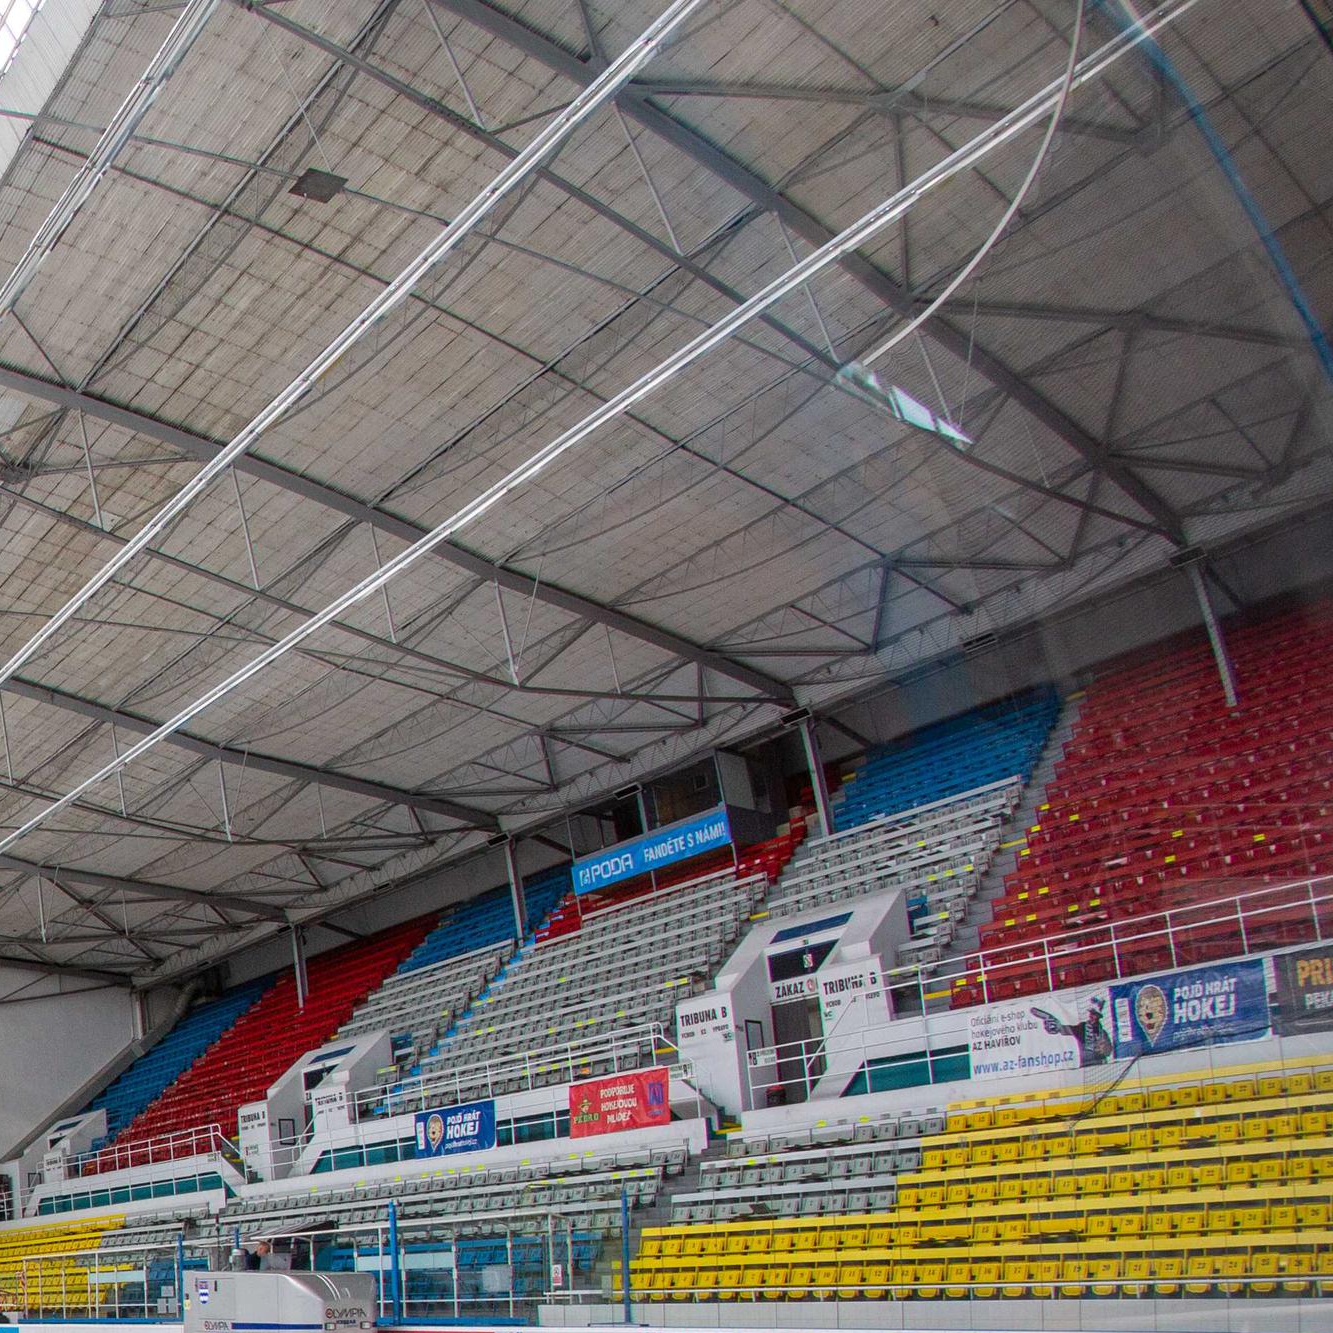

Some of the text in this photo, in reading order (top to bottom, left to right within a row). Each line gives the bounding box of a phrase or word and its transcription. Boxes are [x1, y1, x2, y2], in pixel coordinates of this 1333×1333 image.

[591, 824, 727, 885] PODA FANDĚTE S NÁMI!
[775, 979, 805, 999] ZÁKAZ
[680, 1006, 728, 1028] TRIBUNA B
[1173, 993, 1237, 1024] HOKEJ
[972, 1040, 982, 1052] AZ
[973, 1049, 1075, 1076] www.az-fanshop.cz
[446, 1121, 480, 1139] HOKEJ
[324, 1308, 366, 1319] OLYMPIA
[204, 1320, 229, 1331] OLYMPIA
